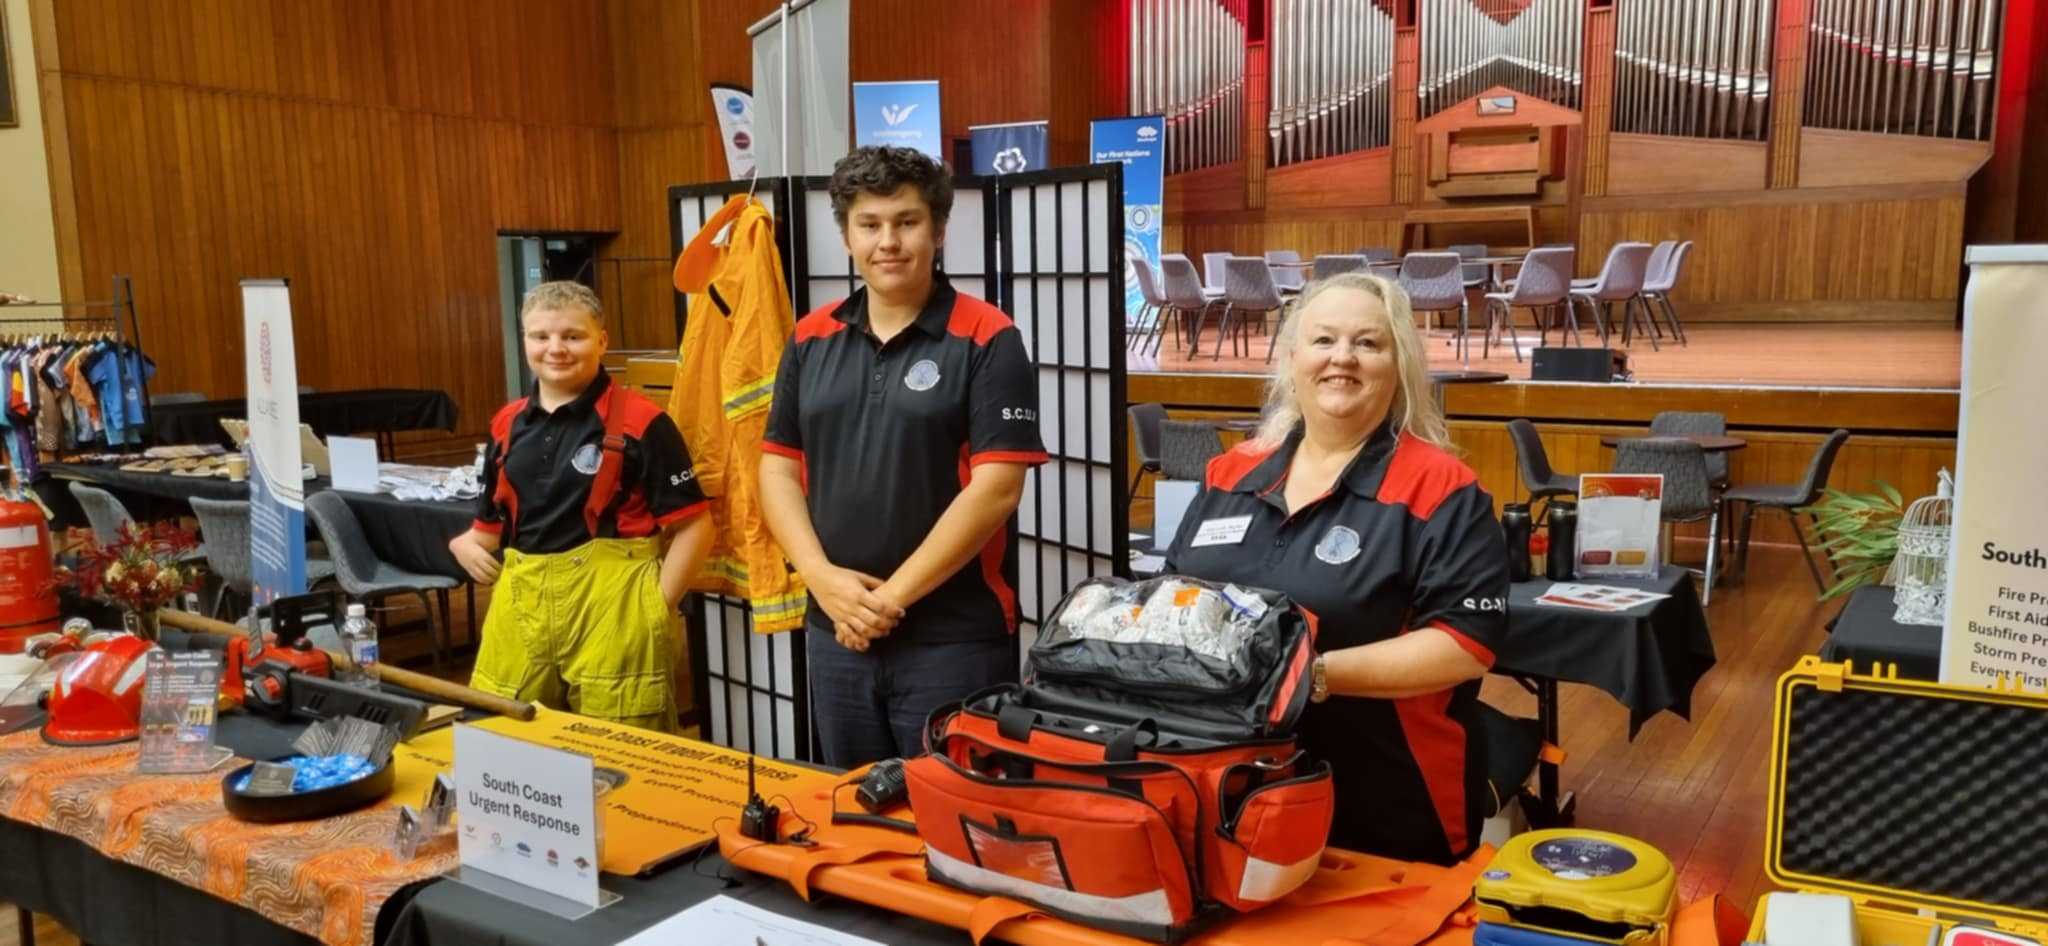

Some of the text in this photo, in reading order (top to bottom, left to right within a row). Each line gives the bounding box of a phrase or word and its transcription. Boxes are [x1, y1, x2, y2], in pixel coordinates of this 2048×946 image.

[1981, 541, 2047, 569] South
[1998, 586, 2026, 603] Fire
[1988, 604, 2048, 627] First Aid
[1968, 620, 2028, 644] Bushfire
[1973, 642, 2017, 662] Storm
[561, 721, 613, 737] South
[607, 731, 661, 748] Coast
[652, 741, 716, 761] Urgent
[482, 772, 562, 808] South Coast
[468, 790, 581, 836] Urgent Response
